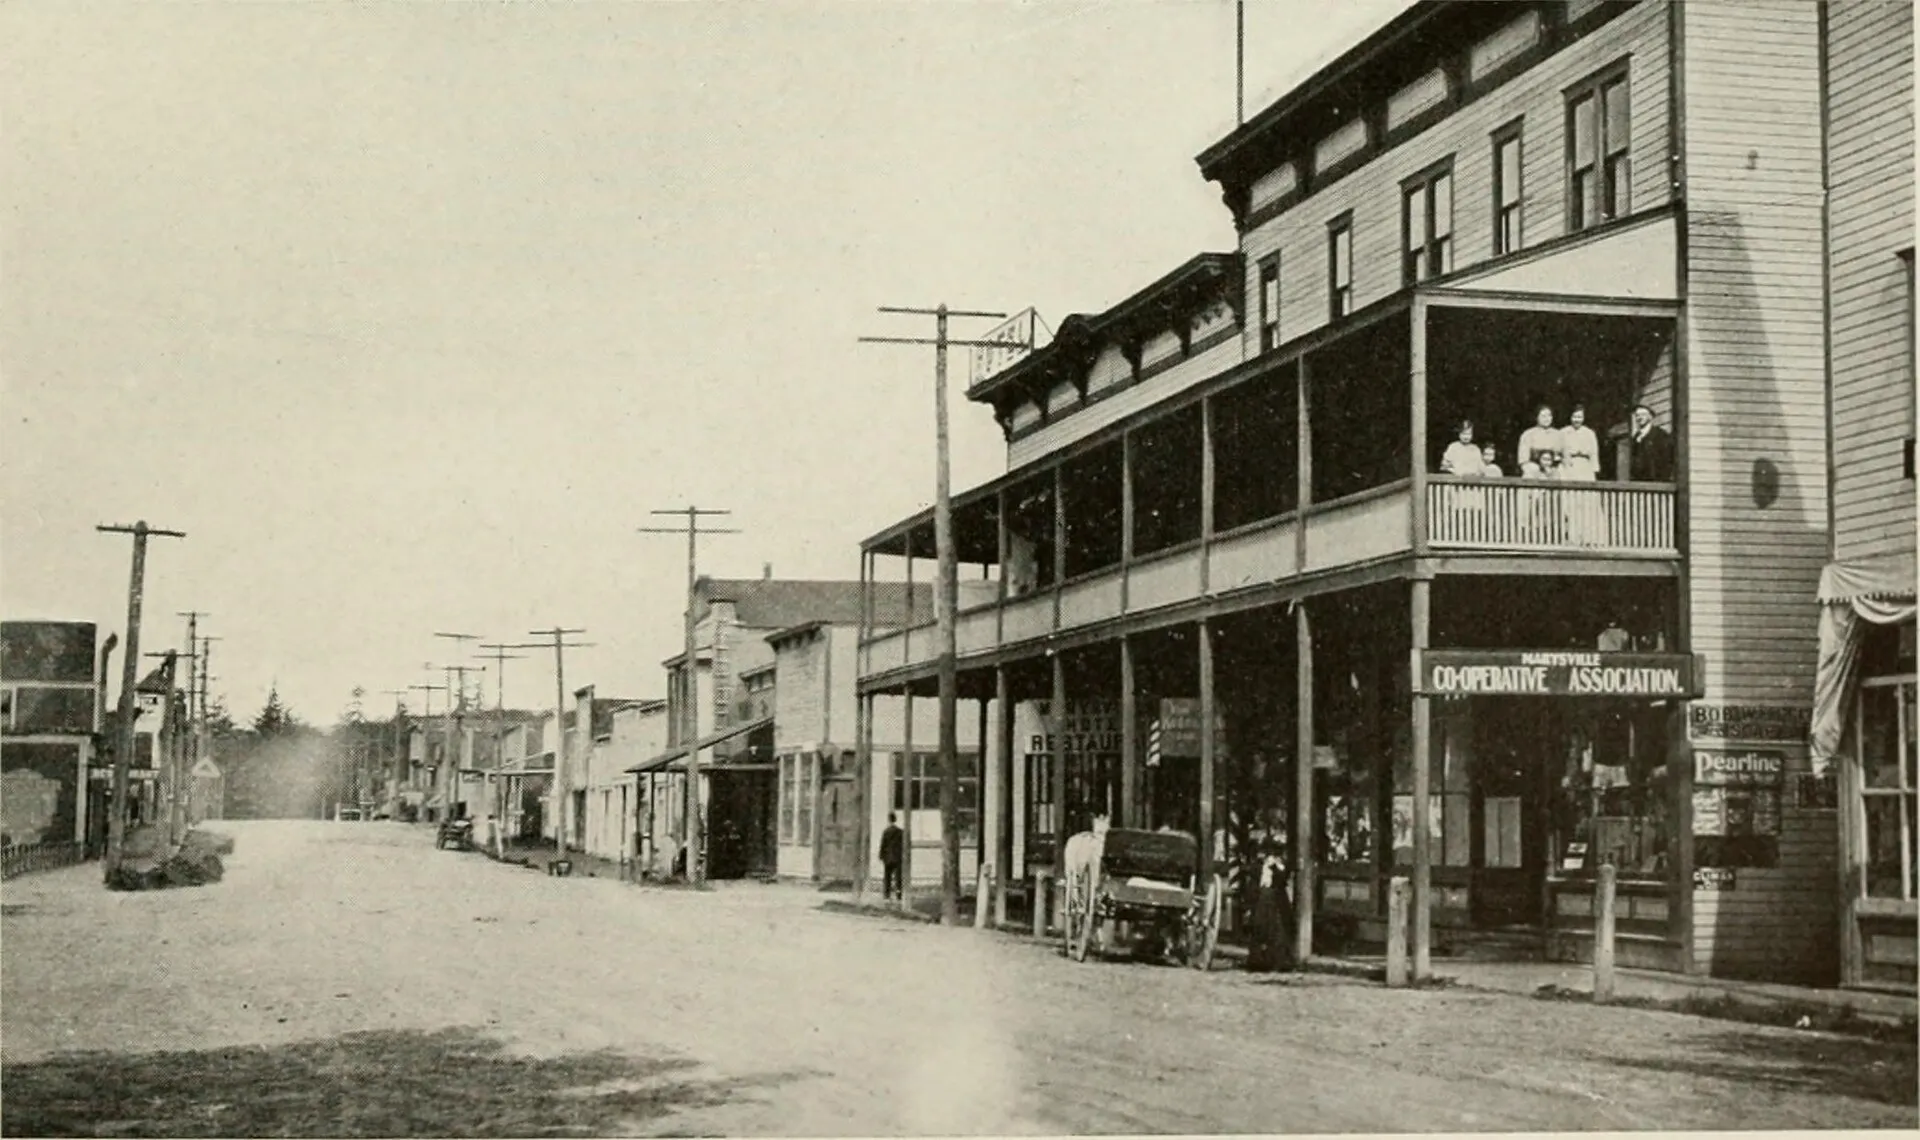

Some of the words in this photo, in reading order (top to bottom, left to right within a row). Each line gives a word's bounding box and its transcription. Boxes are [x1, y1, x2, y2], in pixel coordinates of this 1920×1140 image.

[1521, 652, 1600, 666] MARYSVILLE
[1433, 665, 1549, 692] CO-OPERATIVE
[1568, 667, 1684, 693] ASSOCIATION.
[1694, 751, 1781, 783] Pearline
